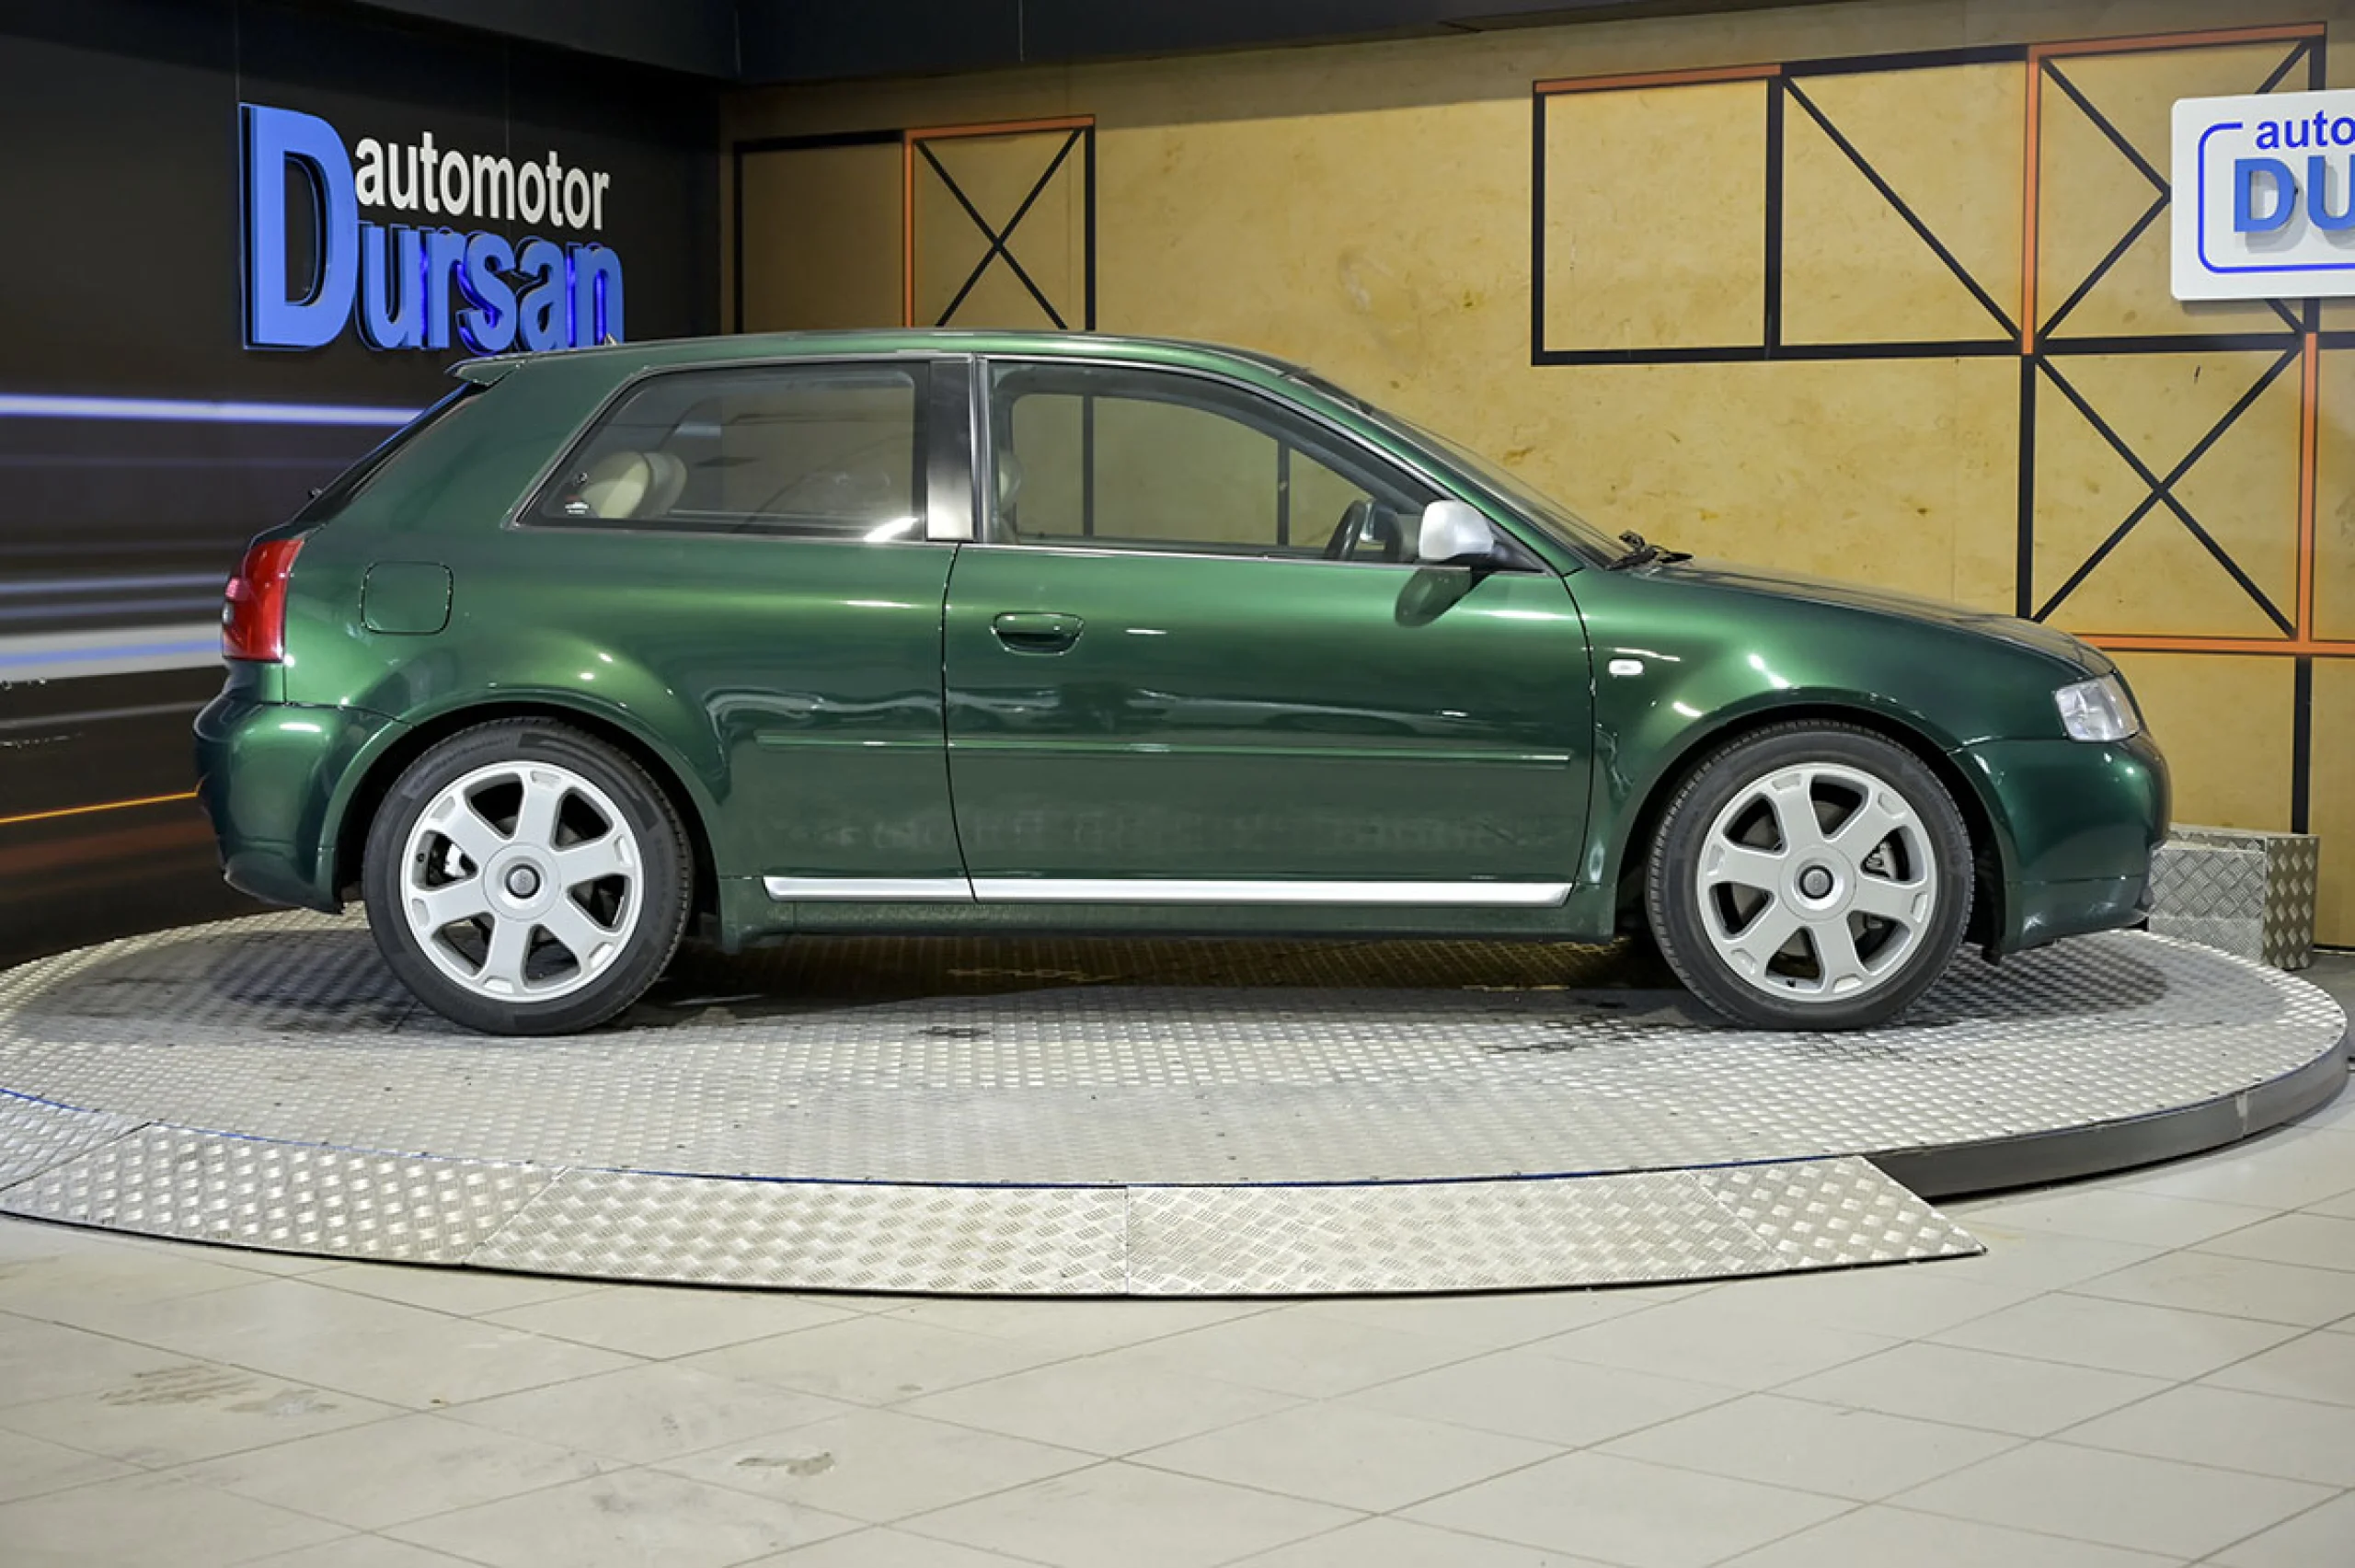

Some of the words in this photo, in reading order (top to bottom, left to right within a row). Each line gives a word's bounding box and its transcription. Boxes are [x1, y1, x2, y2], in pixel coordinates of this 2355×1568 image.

[2256, 109, 2355, 150] auto
[239, 102, 625, 352] Dursan
[355, 131, 610, 230] automotor
